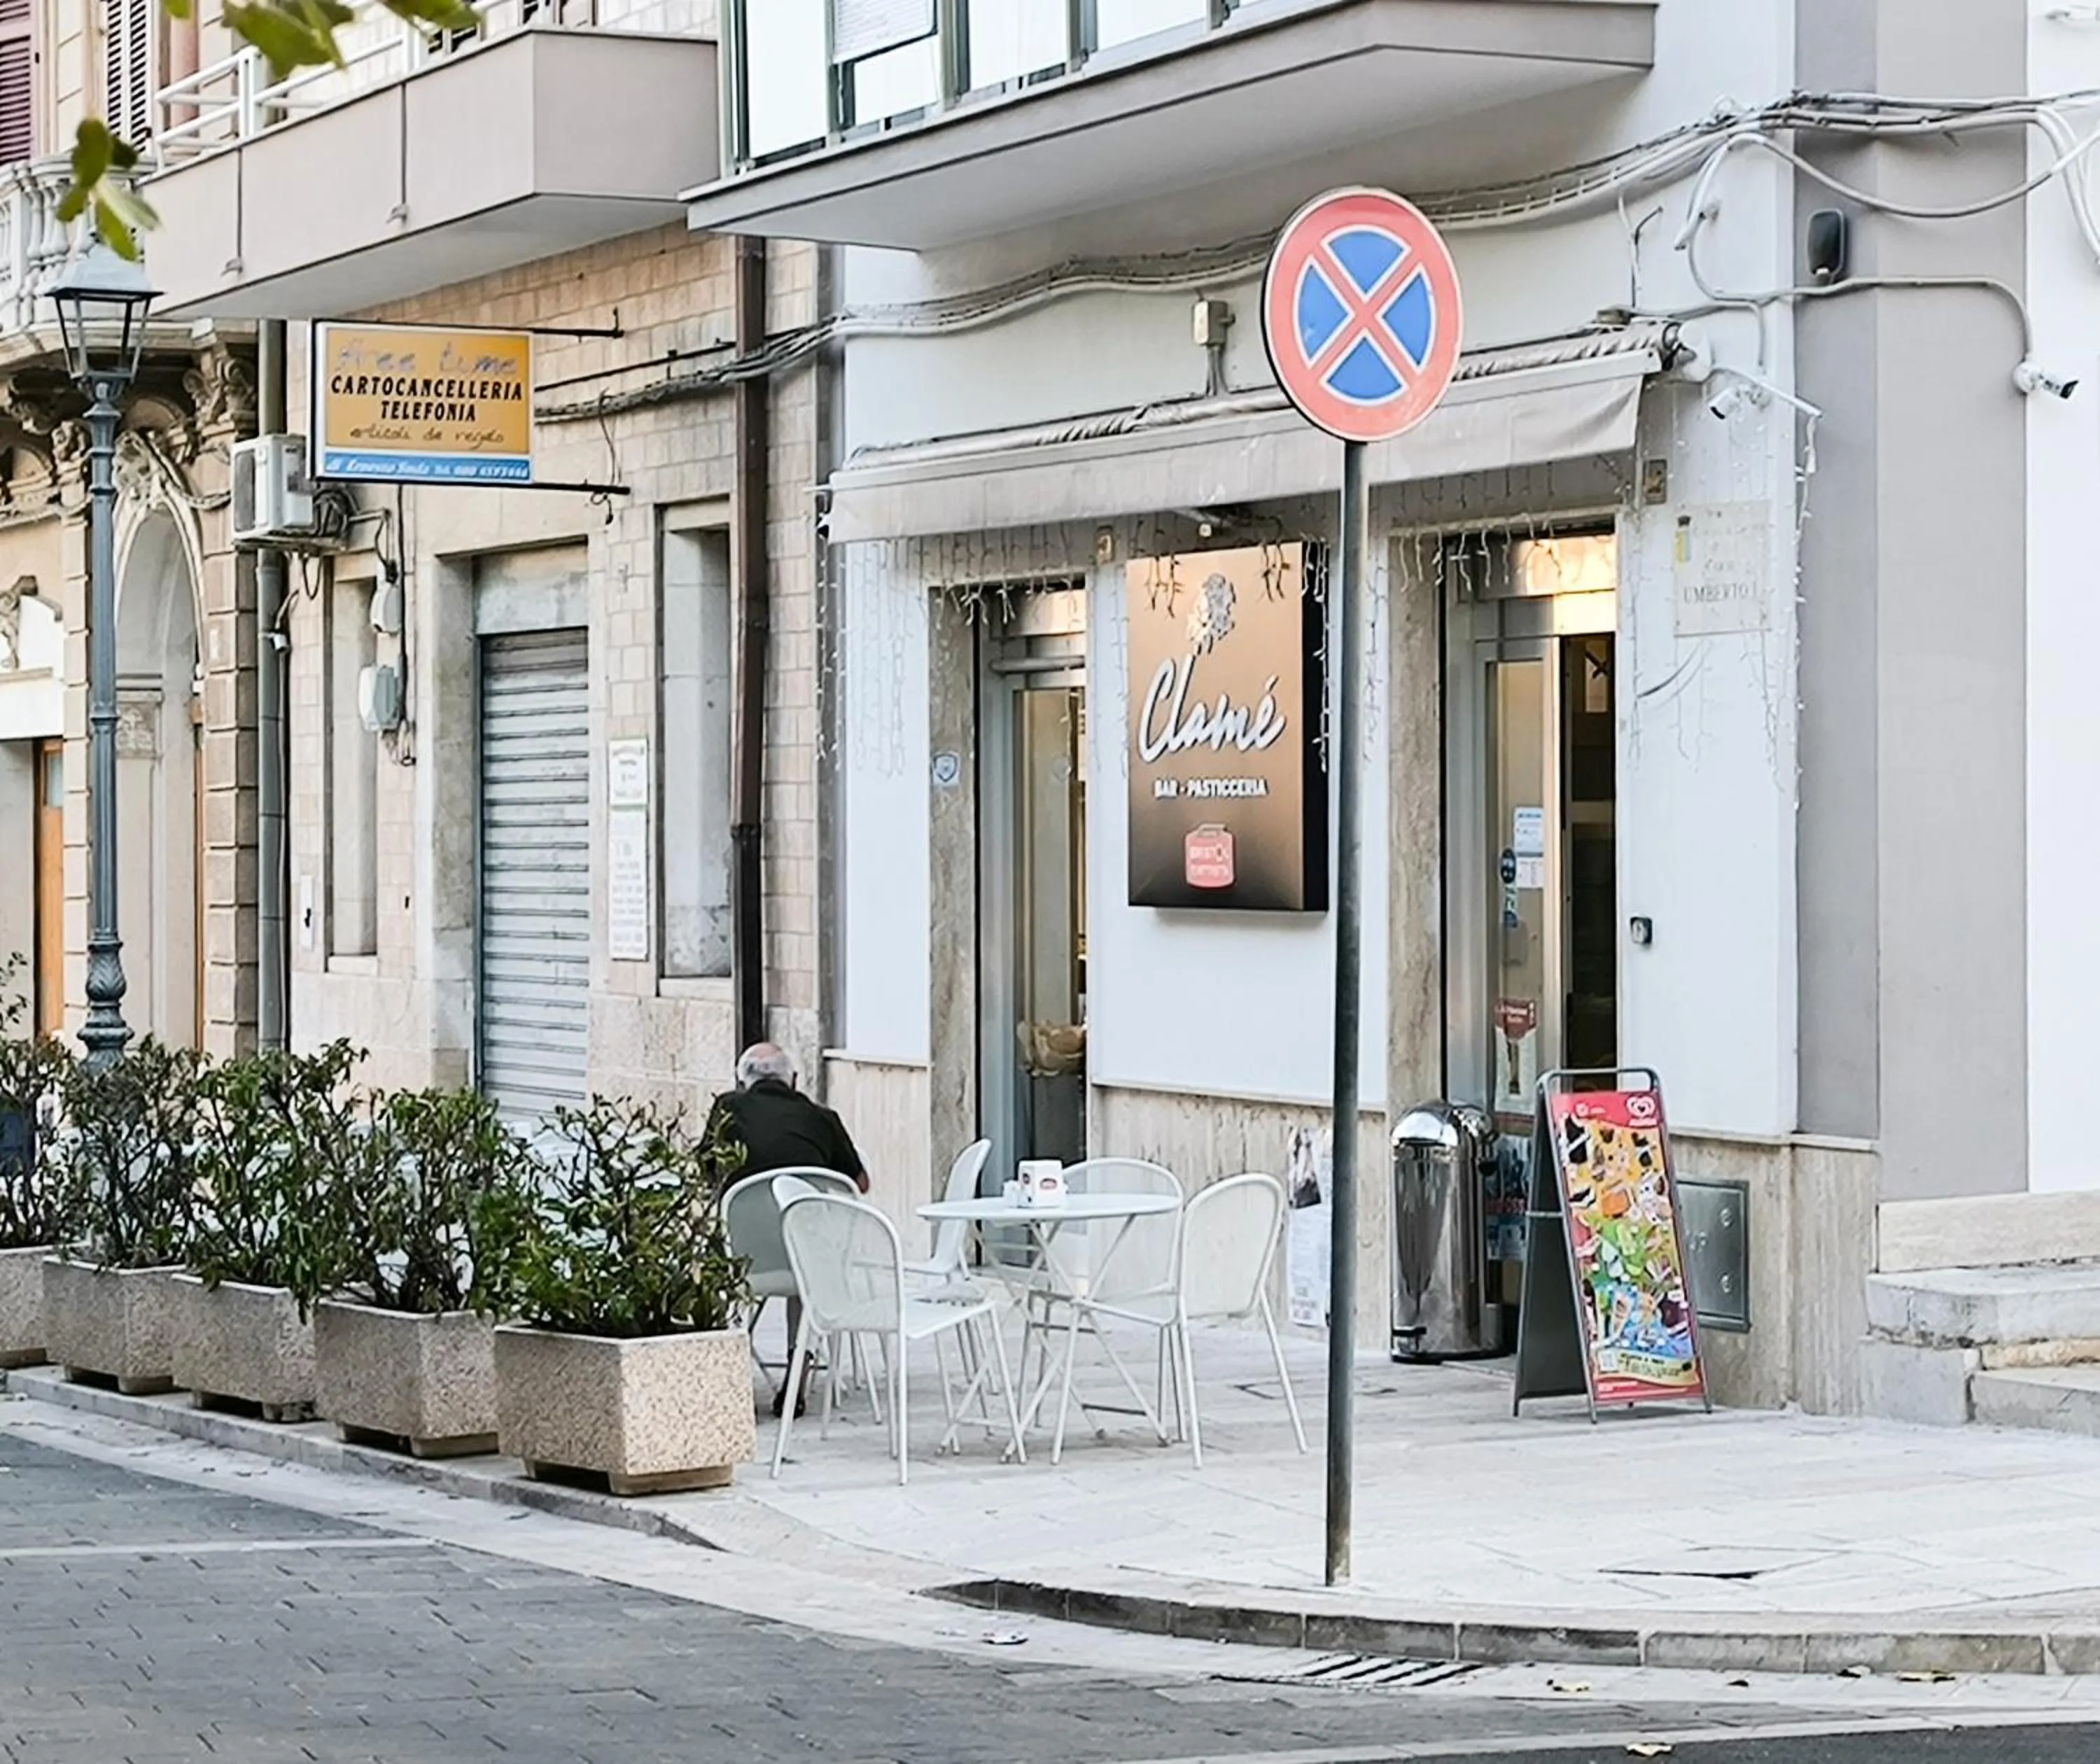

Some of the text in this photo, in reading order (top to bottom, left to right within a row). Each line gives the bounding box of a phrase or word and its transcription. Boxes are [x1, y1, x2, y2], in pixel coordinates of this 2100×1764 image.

[331, 375, 523, 400] CARTOCANCELLERIA
[381, 400, 477, 422] TELEFONIA
[1138, 653, 1287, 763] Clamé
[1154, 778, 1179, 797] BAR
[1186, 778, 1268, 797] PASTICCERIA
